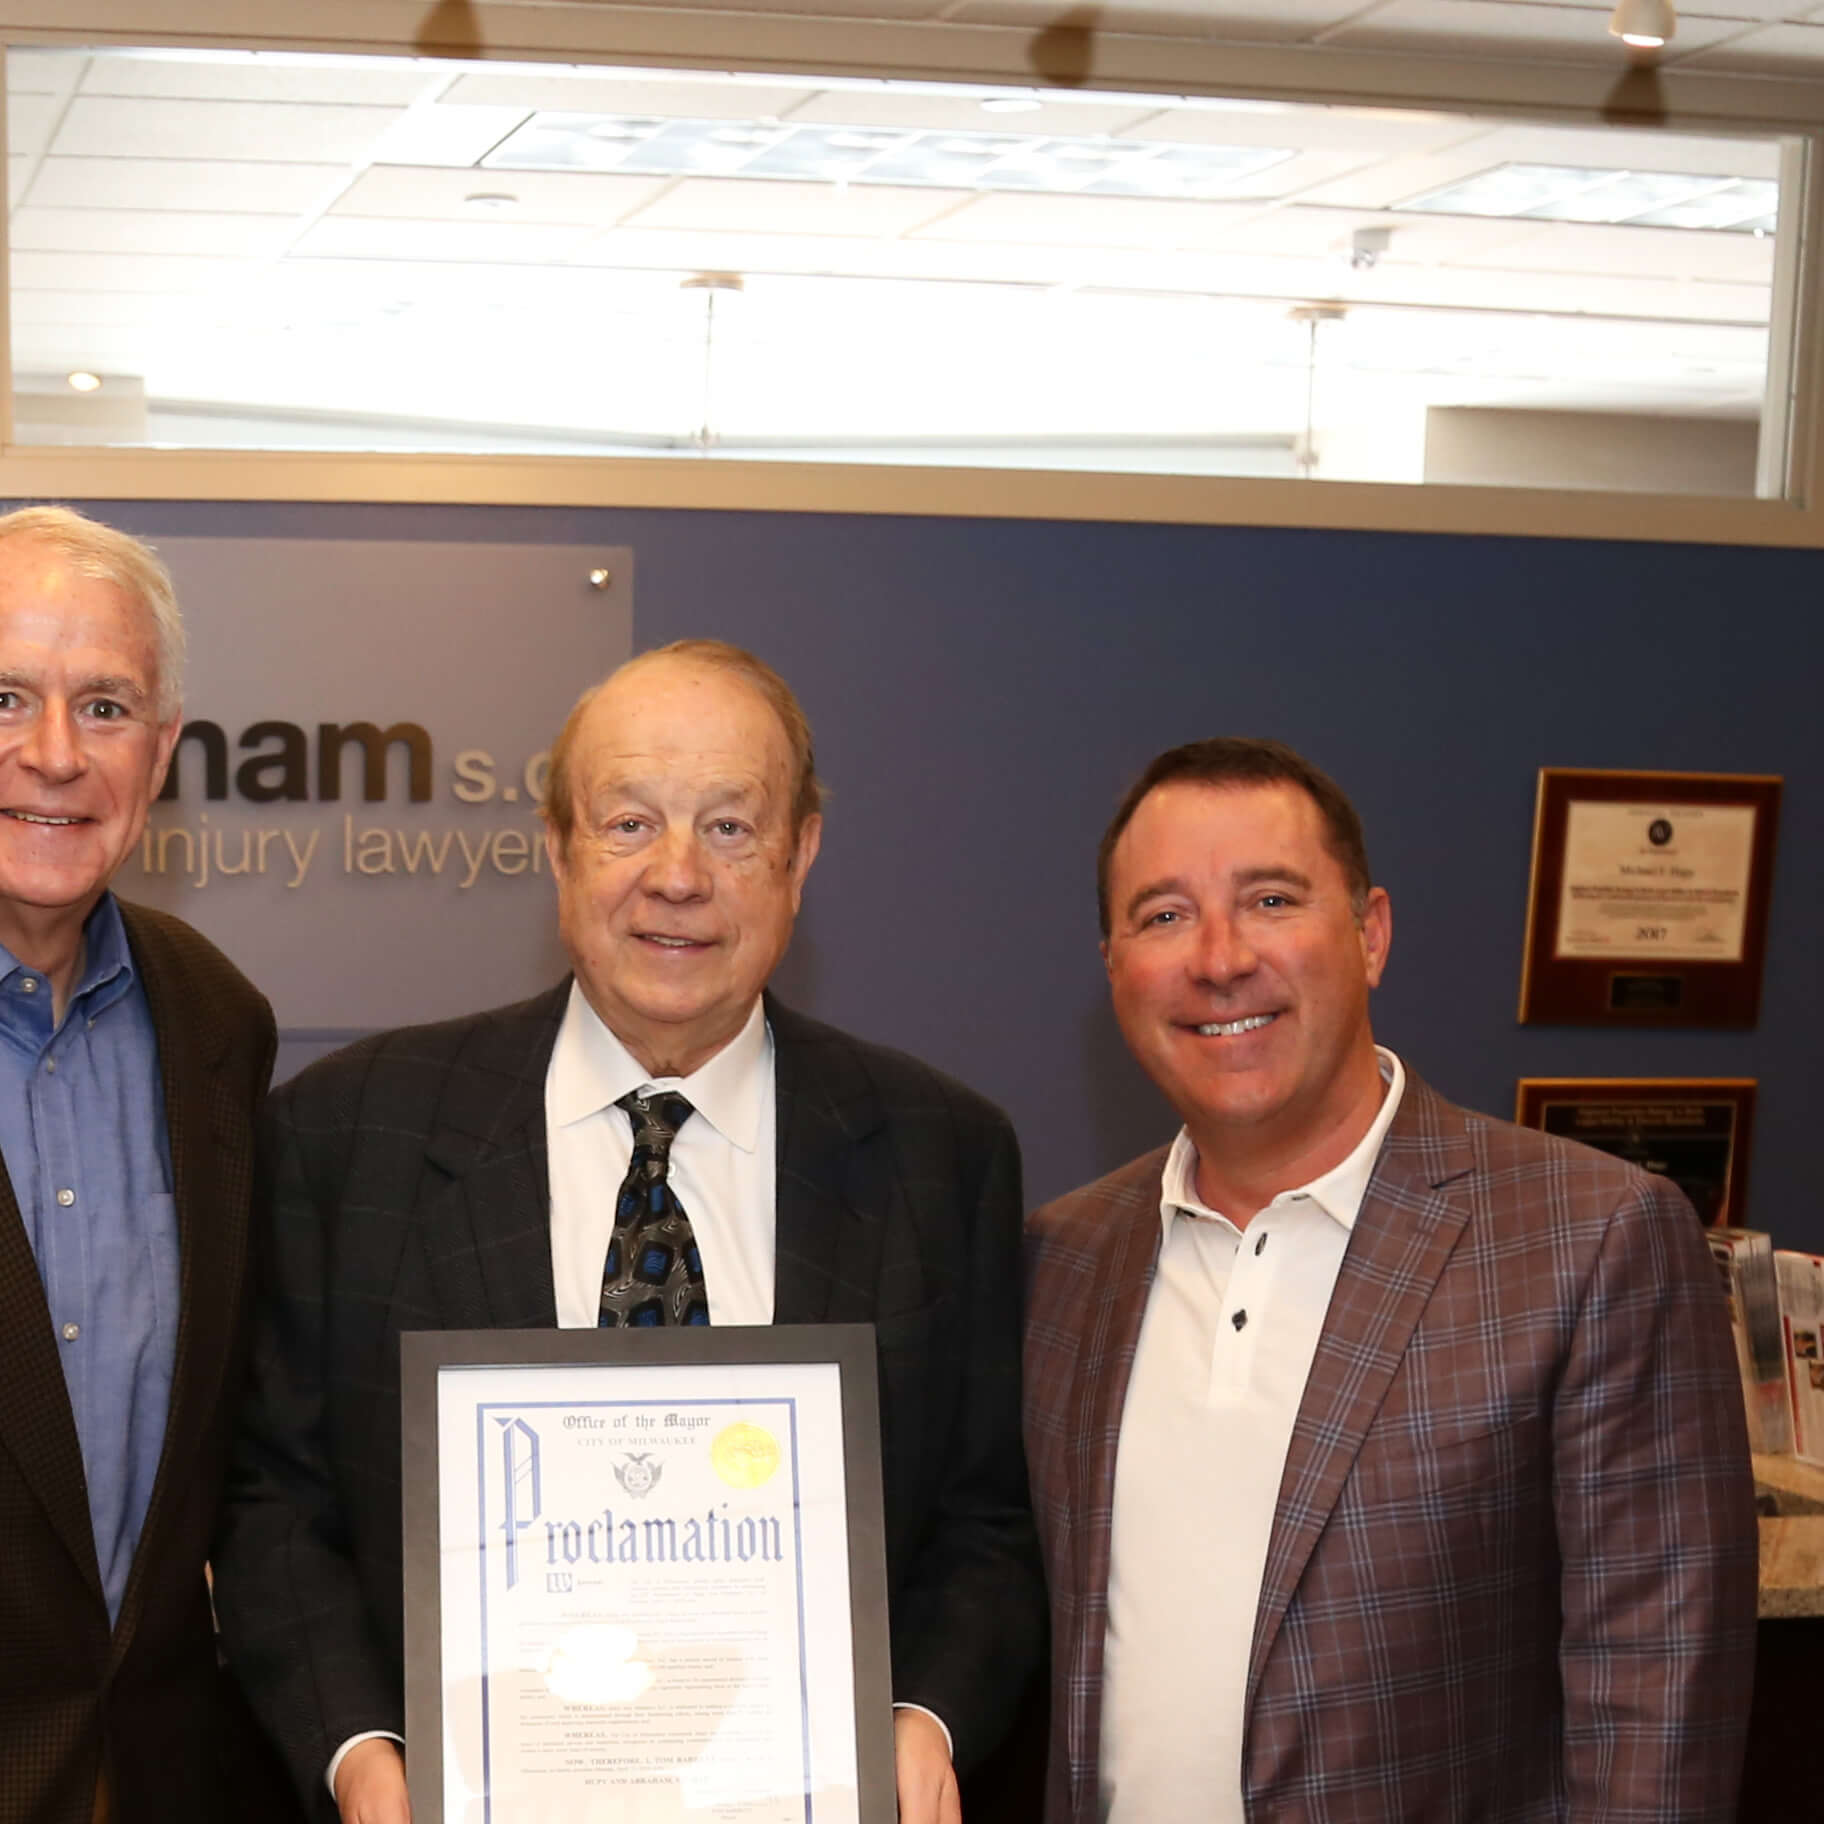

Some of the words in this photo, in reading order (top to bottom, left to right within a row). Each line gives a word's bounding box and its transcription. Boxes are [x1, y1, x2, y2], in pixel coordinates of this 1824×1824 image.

[142, 813, 319, 888] injury
[344, 815, 546, 888] lawyer
[562, 1414, 606, 1430] Office
[613, 1414, 628, 1429] of
[635, 1414, 656, 1431] the
[663, 1412, 711, 1431] Mayor
[492, 1416, 783, 1592] Proclamation
